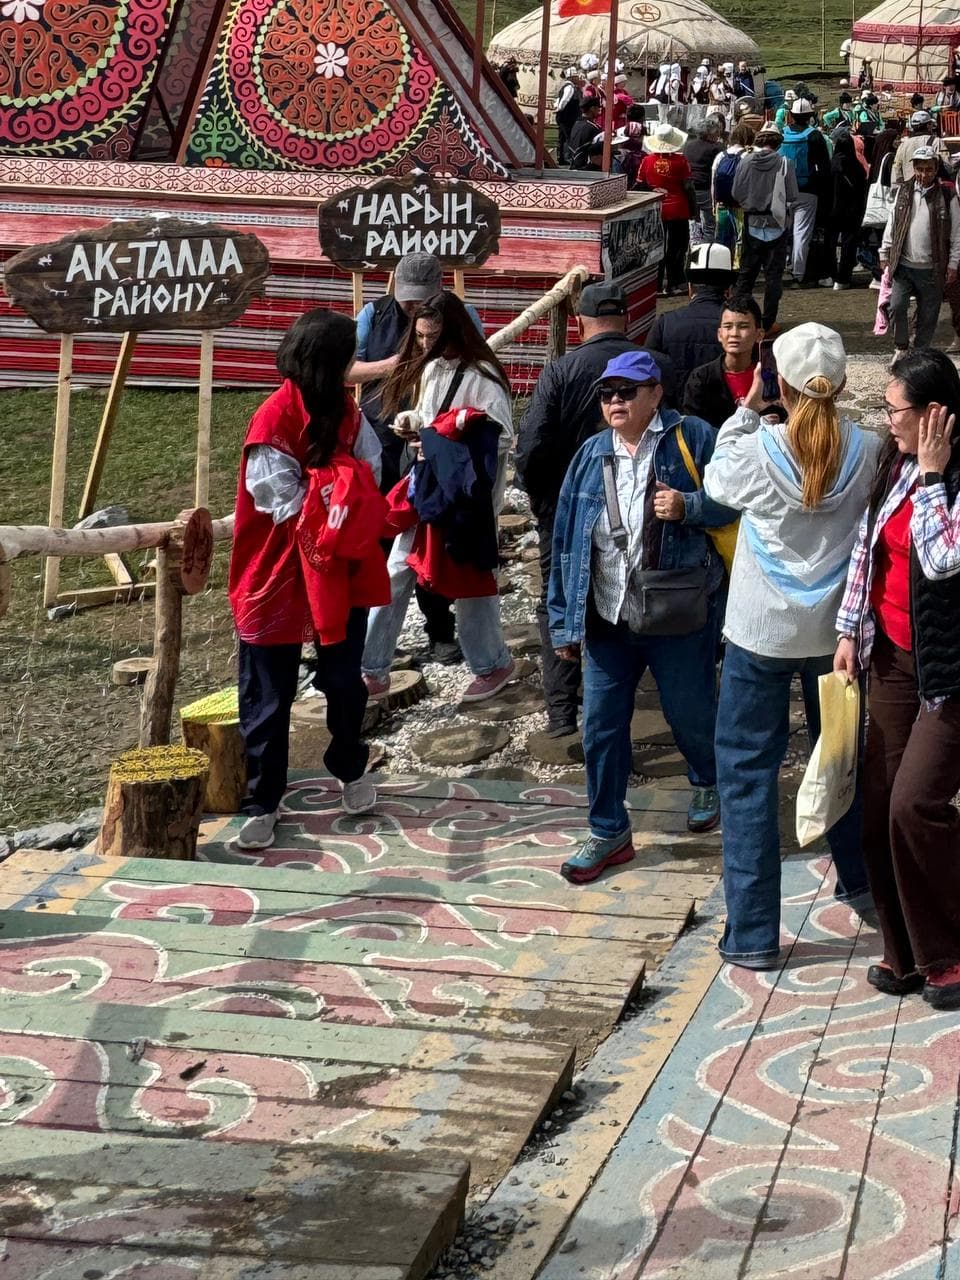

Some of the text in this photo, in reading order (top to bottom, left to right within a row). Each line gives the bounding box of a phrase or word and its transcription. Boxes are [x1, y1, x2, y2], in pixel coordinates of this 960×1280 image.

[352, 192, 473, 225] НАРЫН
[365, 224, 478, 256] РАЙОНУ
[65, 238, 243, 283] АК-ТАЛАА
[92, 280, 215, 317] РАЙОНУ
